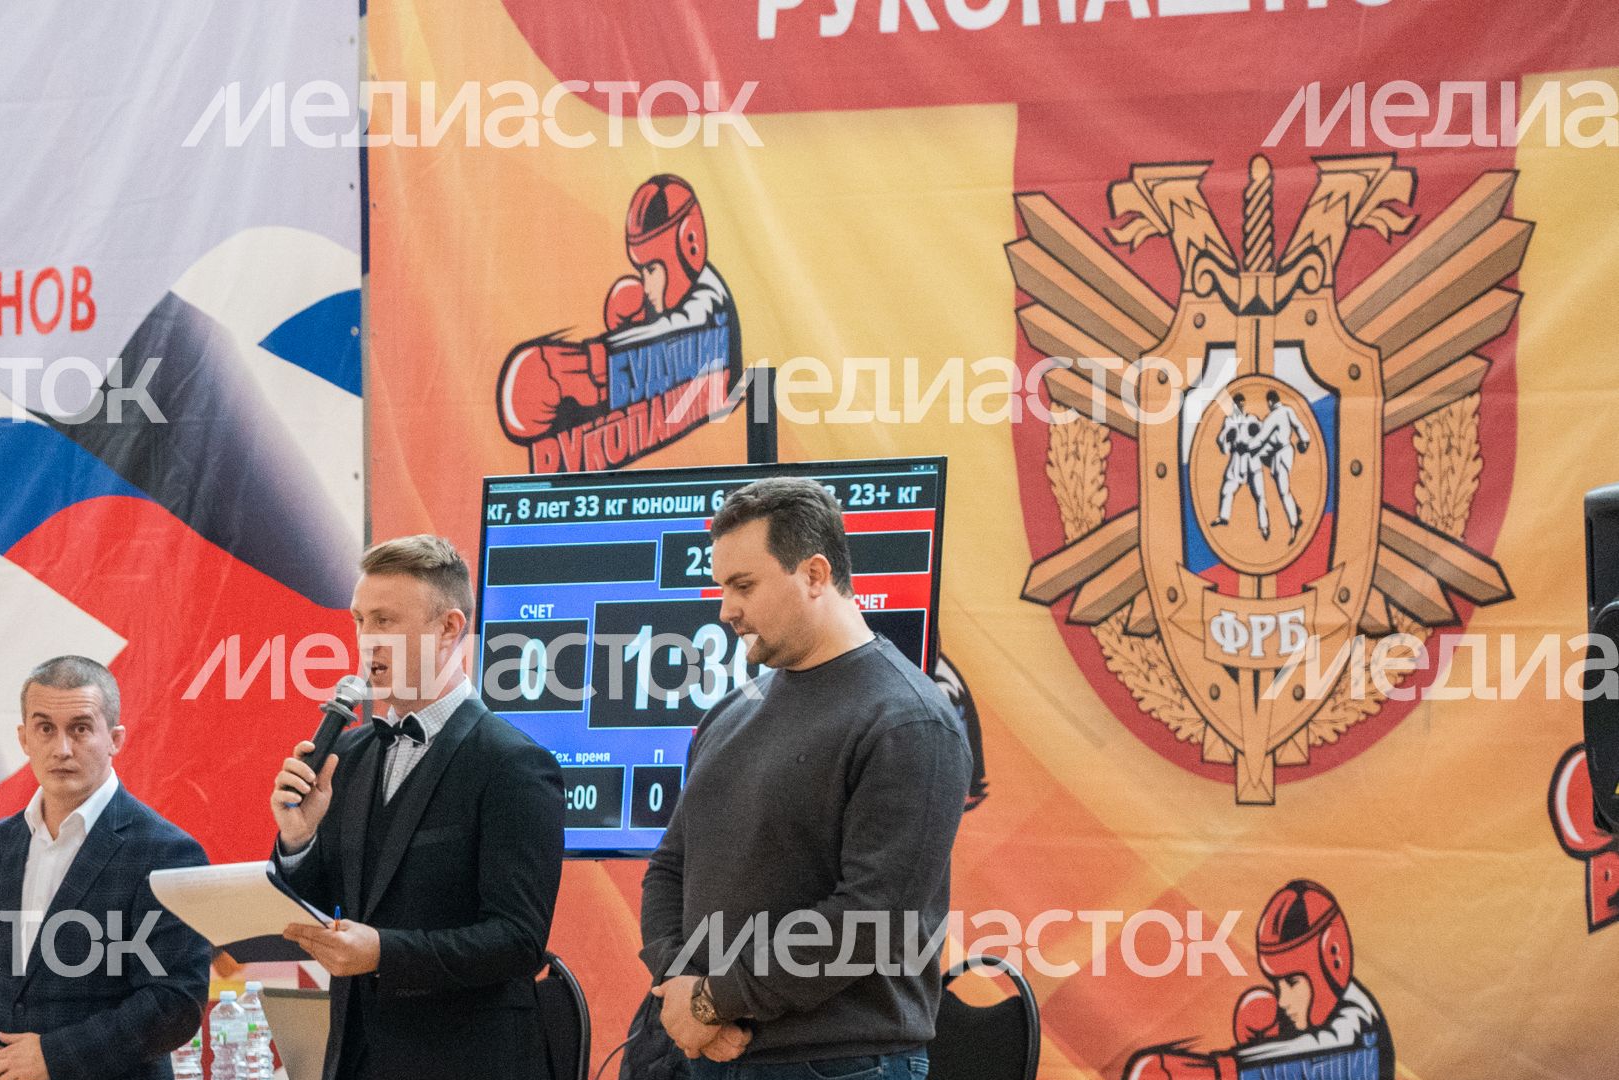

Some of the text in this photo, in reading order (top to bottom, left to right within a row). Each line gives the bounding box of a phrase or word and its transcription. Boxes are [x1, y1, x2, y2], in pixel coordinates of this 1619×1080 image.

[847, 483, 891, 506] 23+
[897, 486, 923, 504] кг
[486, 502, 512, 524] кг,
[516, 497, 531, 520] 8
[533, 500, 570, 518] лет
[573, 494, 600, 517] 33
[604, 498, 628, 516] кг
[631, 495, 706, 515] юноши
[519, 603, 555, 620] СЧЕТ
[1209, 608, 1309, 657] ФРБ
[575, 751, 611, 765] время
[653, 748, 664, 764] П
[648, 782, 663, 813] 0
